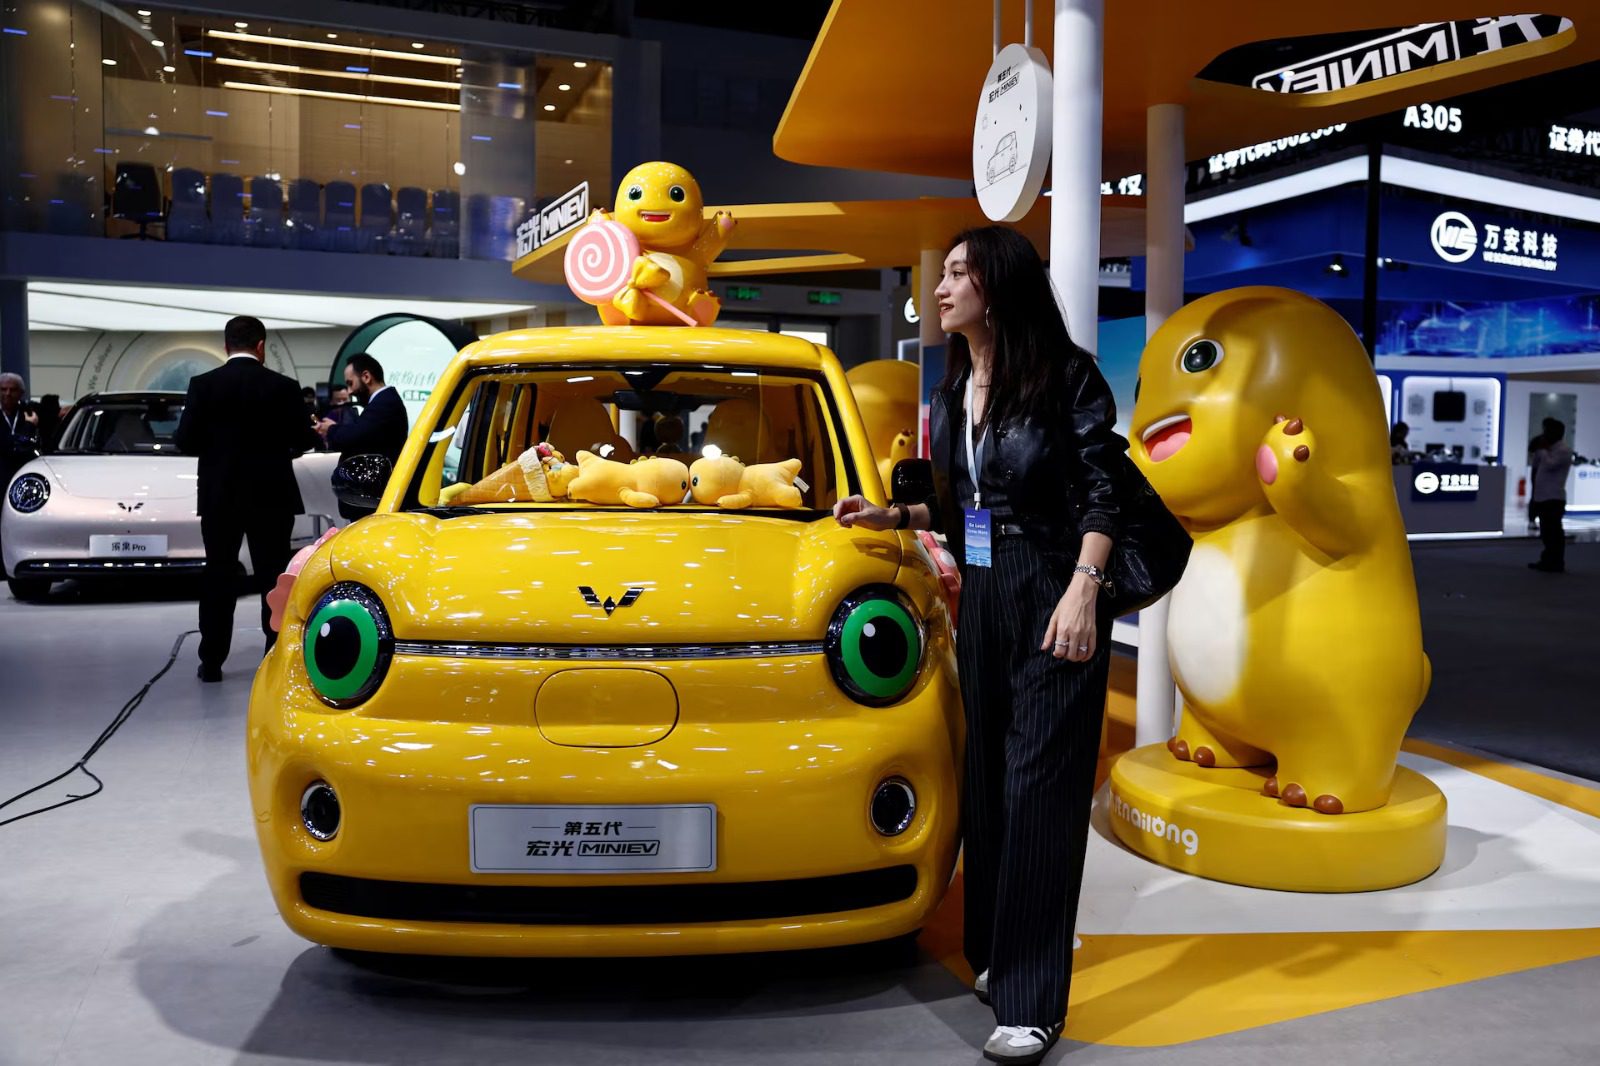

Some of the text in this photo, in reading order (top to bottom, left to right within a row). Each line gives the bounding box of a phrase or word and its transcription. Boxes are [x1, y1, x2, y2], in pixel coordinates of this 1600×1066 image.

[1403, 103, 1462, 133] A305
[1483, 223, 1558, 259] 万安科技
[564, 821, 622, 836] 第五代
[526, 841, 656, 856] 宏光 MINIEV
